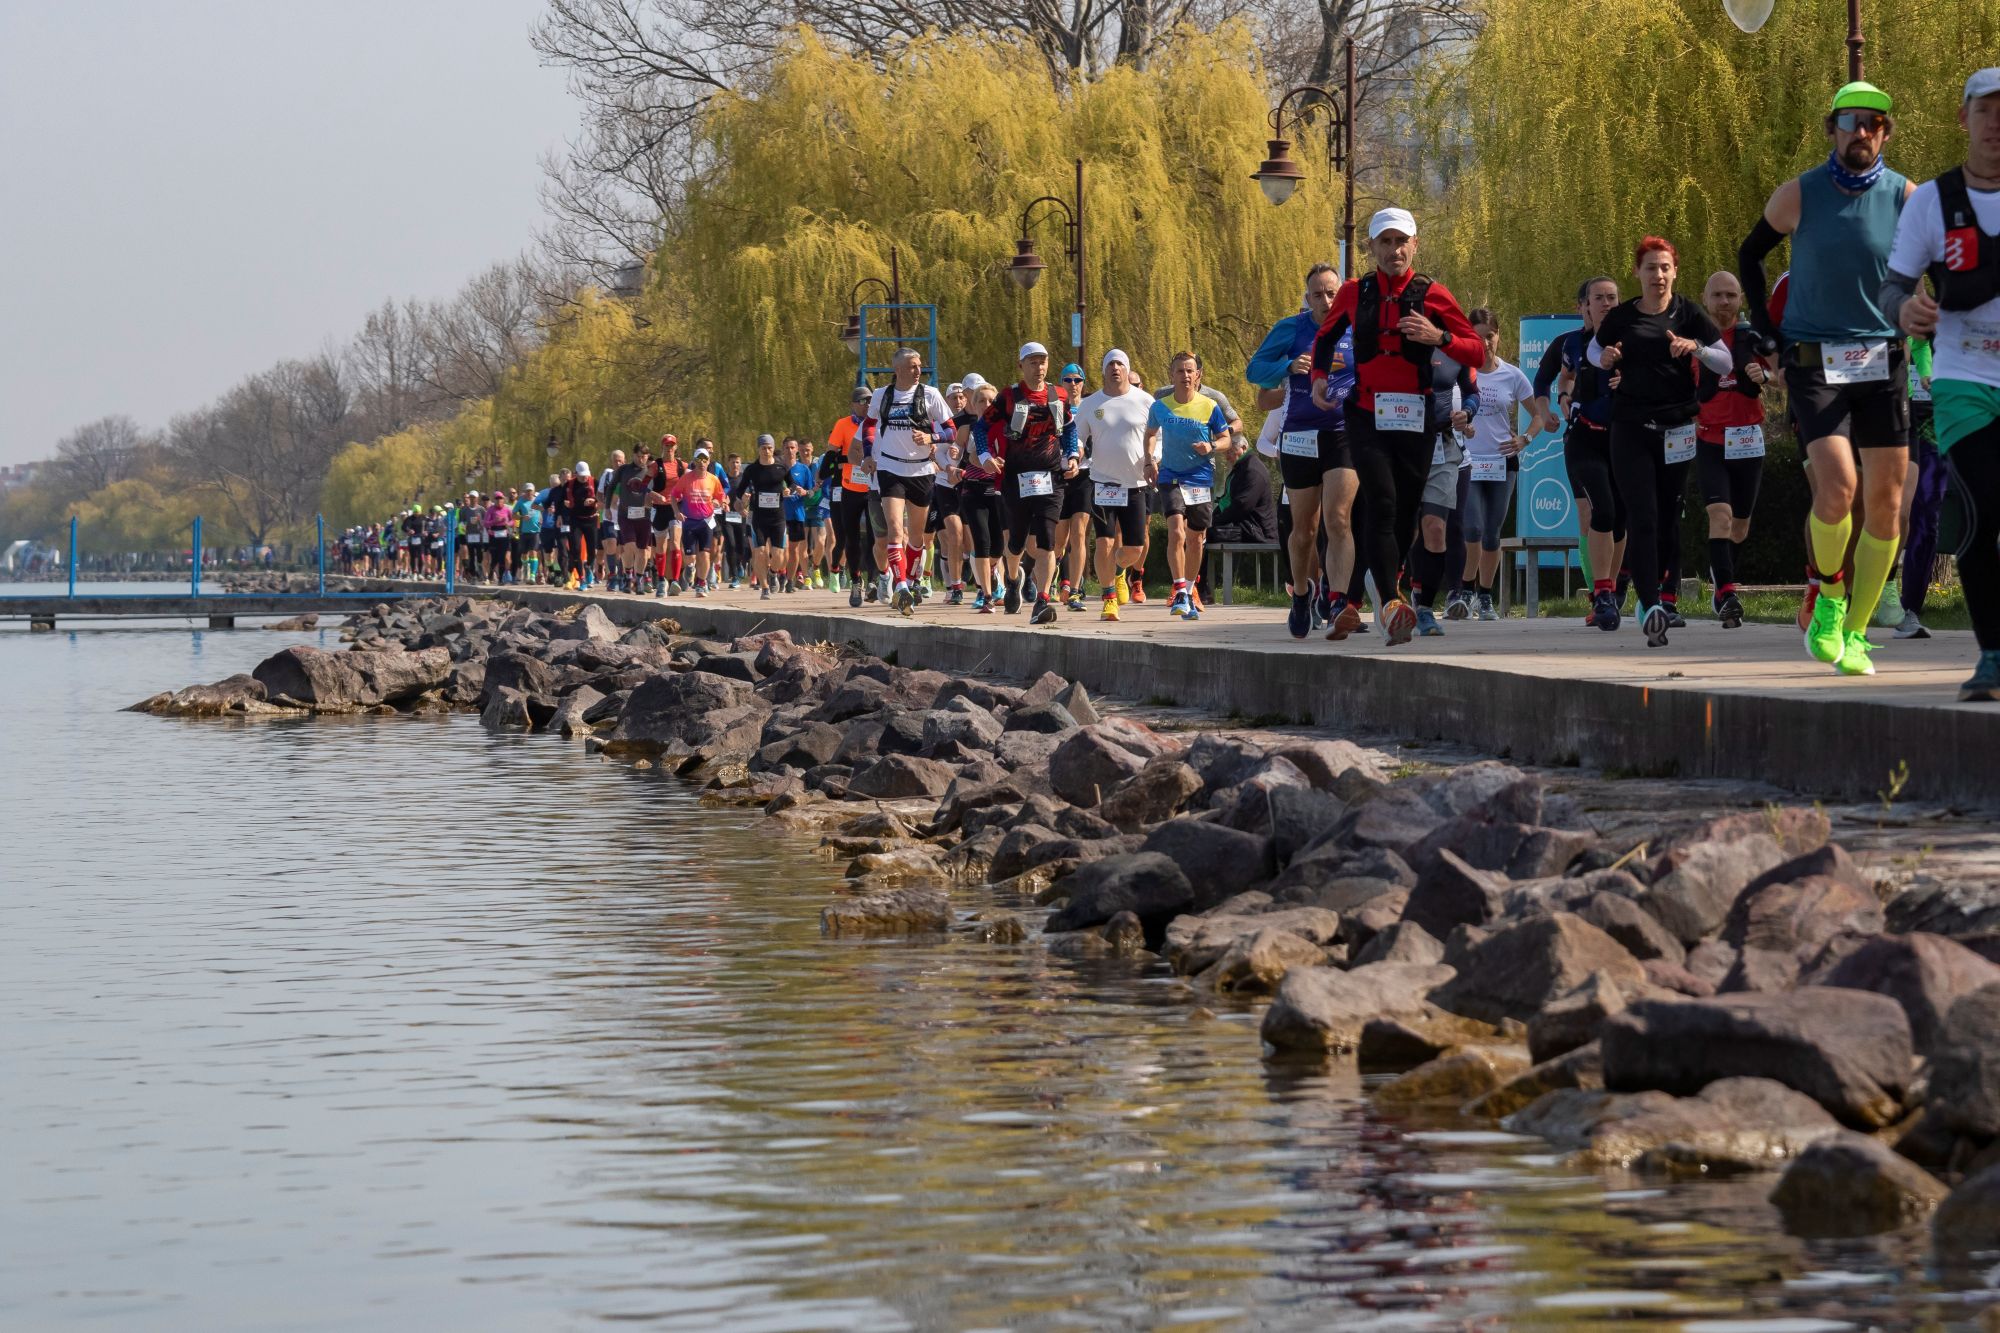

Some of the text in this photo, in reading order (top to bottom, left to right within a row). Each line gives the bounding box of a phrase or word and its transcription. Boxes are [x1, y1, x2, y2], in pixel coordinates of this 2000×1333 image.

[1844, 350, 1869, 361] 222
[1394, 405, 1409, 414] 160
[1288, 435, 1305, 443] 3507
[1739, 437, 1754, 445] 306
[1535, 497, 1562, 511] Wolt
